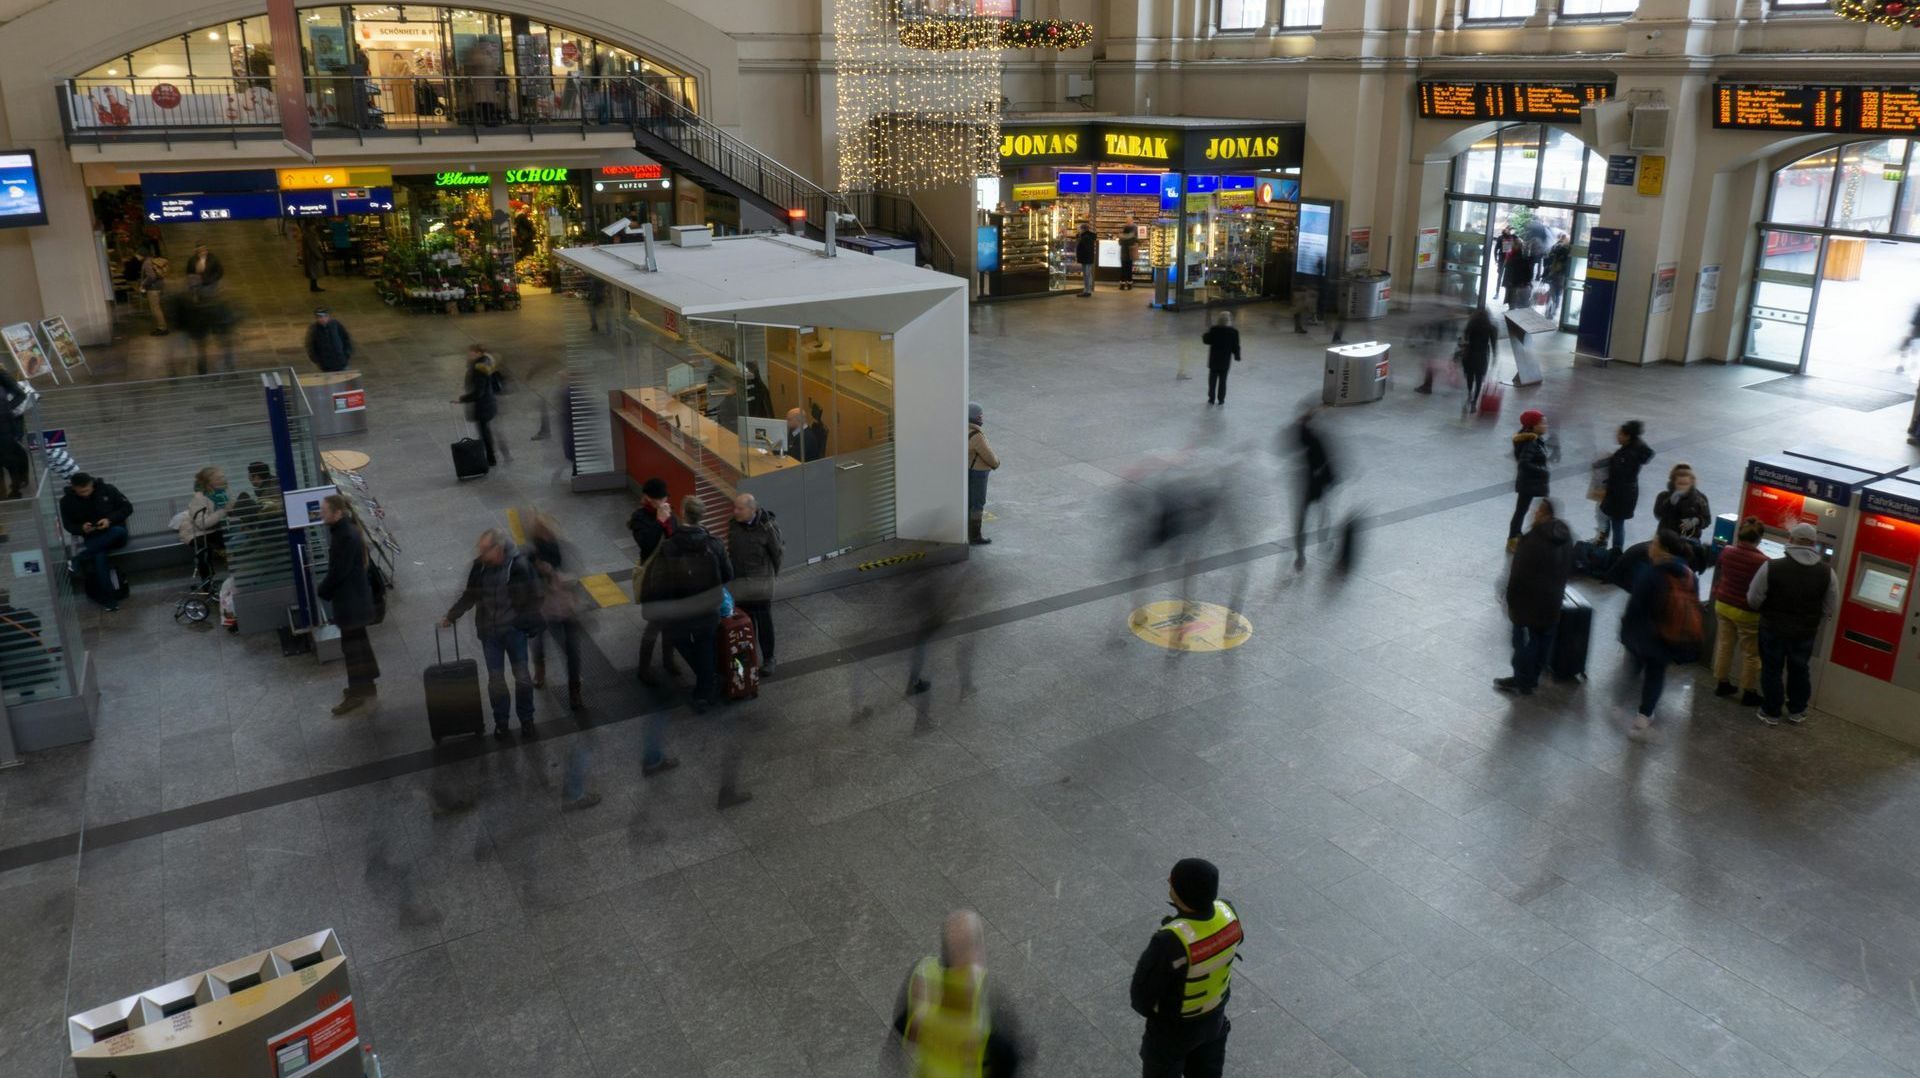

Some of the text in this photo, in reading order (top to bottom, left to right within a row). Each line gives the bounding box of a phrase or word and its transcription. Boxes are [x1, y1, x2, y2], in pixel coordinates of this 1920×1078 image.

[380, 27, 418, 35] SCHÖNHEIT
[1000, 134, 1078, 157] JONAS
[1105, 134, 1169, 159] TABAK
[1205, 136, 1280, 160] JONAS
[506, 168, 567, 183] SCHOR
[1753, 466, 1798, 484] Fahrkarten
[1868, 494, 1919, 513] Fahrkarten
